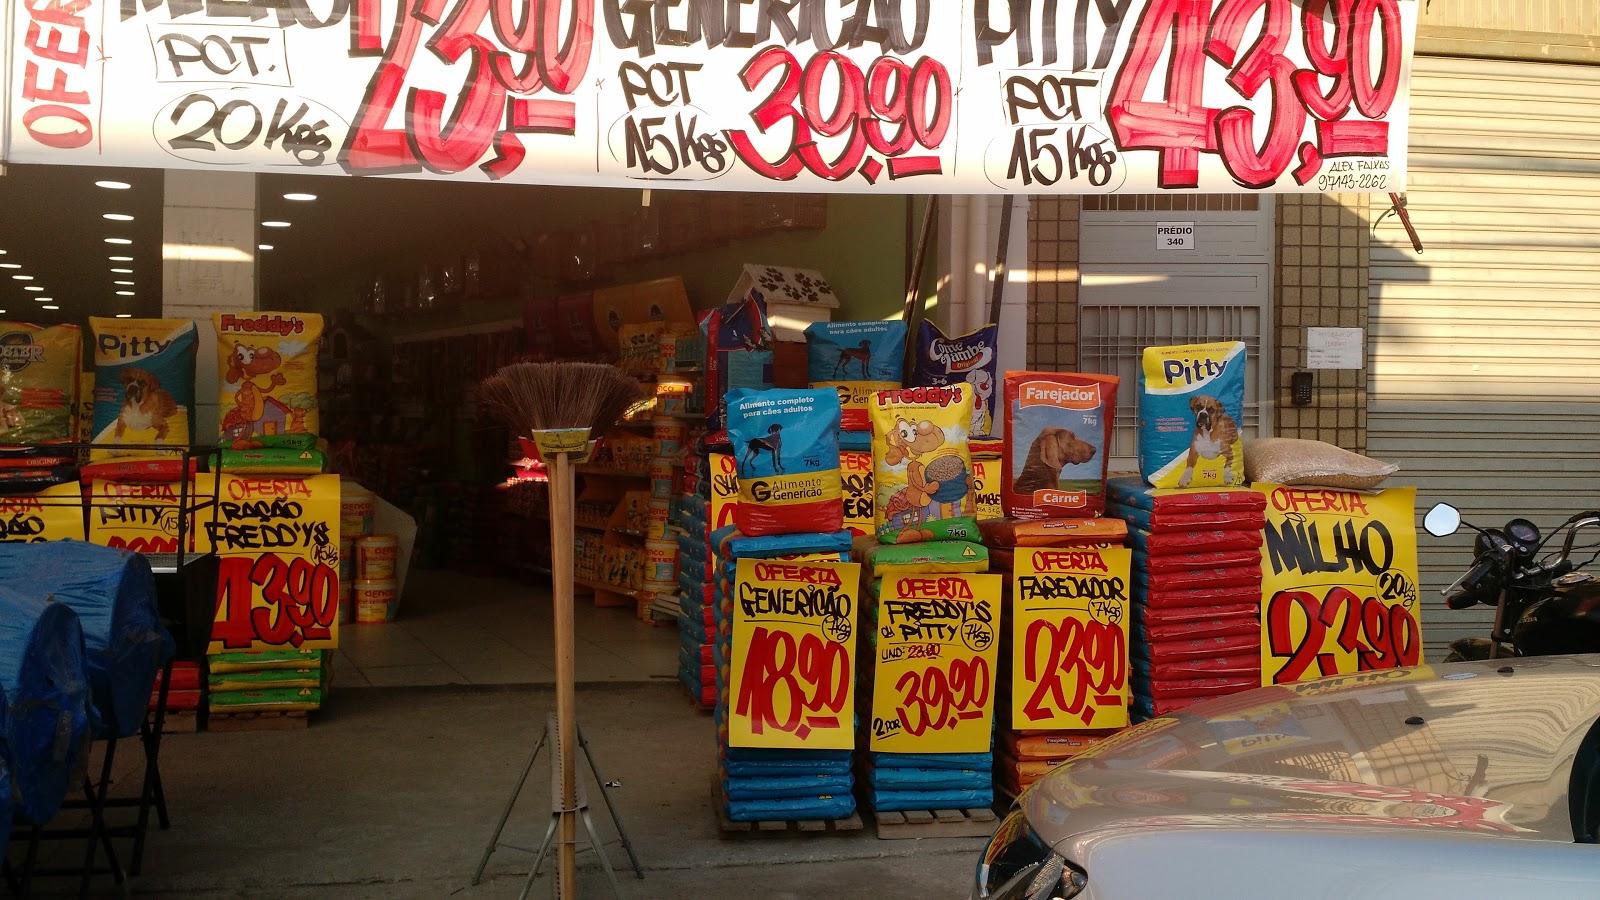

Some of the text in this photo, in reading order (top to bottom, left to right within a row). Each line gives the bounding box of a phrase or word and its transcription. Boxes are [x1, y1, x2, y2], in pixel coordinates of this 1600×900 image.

[617, 61, 704, 111] PCT
[1006, 74, 1099, 125] PCT
[1328, 160, 1390, 173] ALEX FAIXAS
[1317, 174, 1388, 191] 97143-2262
[1157, 225, 1193, 235] PRÉDIO
[1167, 237, 1184, 246] 340
[221, 313, 304, 336] Freddy's
[99, 334, 171, 358] Pitty
[930, 338, 964, 361] Come
[1164, 358, 1228, 385] Pitty
[739, 396, 815, 411] Alimento completo
[1025, 387, 1095, 404] Farejador
[743, 404, 814, 420] para cães adultos
[1082, 417, 1097, 427] 7kg
[804, 458, 821, 467] 7kg
[772, 478, 822, 491] Alimento
[1203, 472, 1217, 480] 7kg
[227, 479, 313, 501] OFERTA
[1042, 493, 1080, 503] Carne
[219, 496, 302, 522] RAÇÃO
[1271, 488, 1369, 516] OFERTA
[947, 528, 967, 538] 7kg
[1264, 512, 1393, 577] MILHO
[1032, 551, 1109, 573] OFERTA
[754, 562, 842, 587] OFERTA
[896, 577, 974, 599] OFERTA
[1018, 575, 1128, 602] FAREJADOR
[884, 598, 993, 624] FREDDY'S
[899, 621, 958, 641] PITTY
